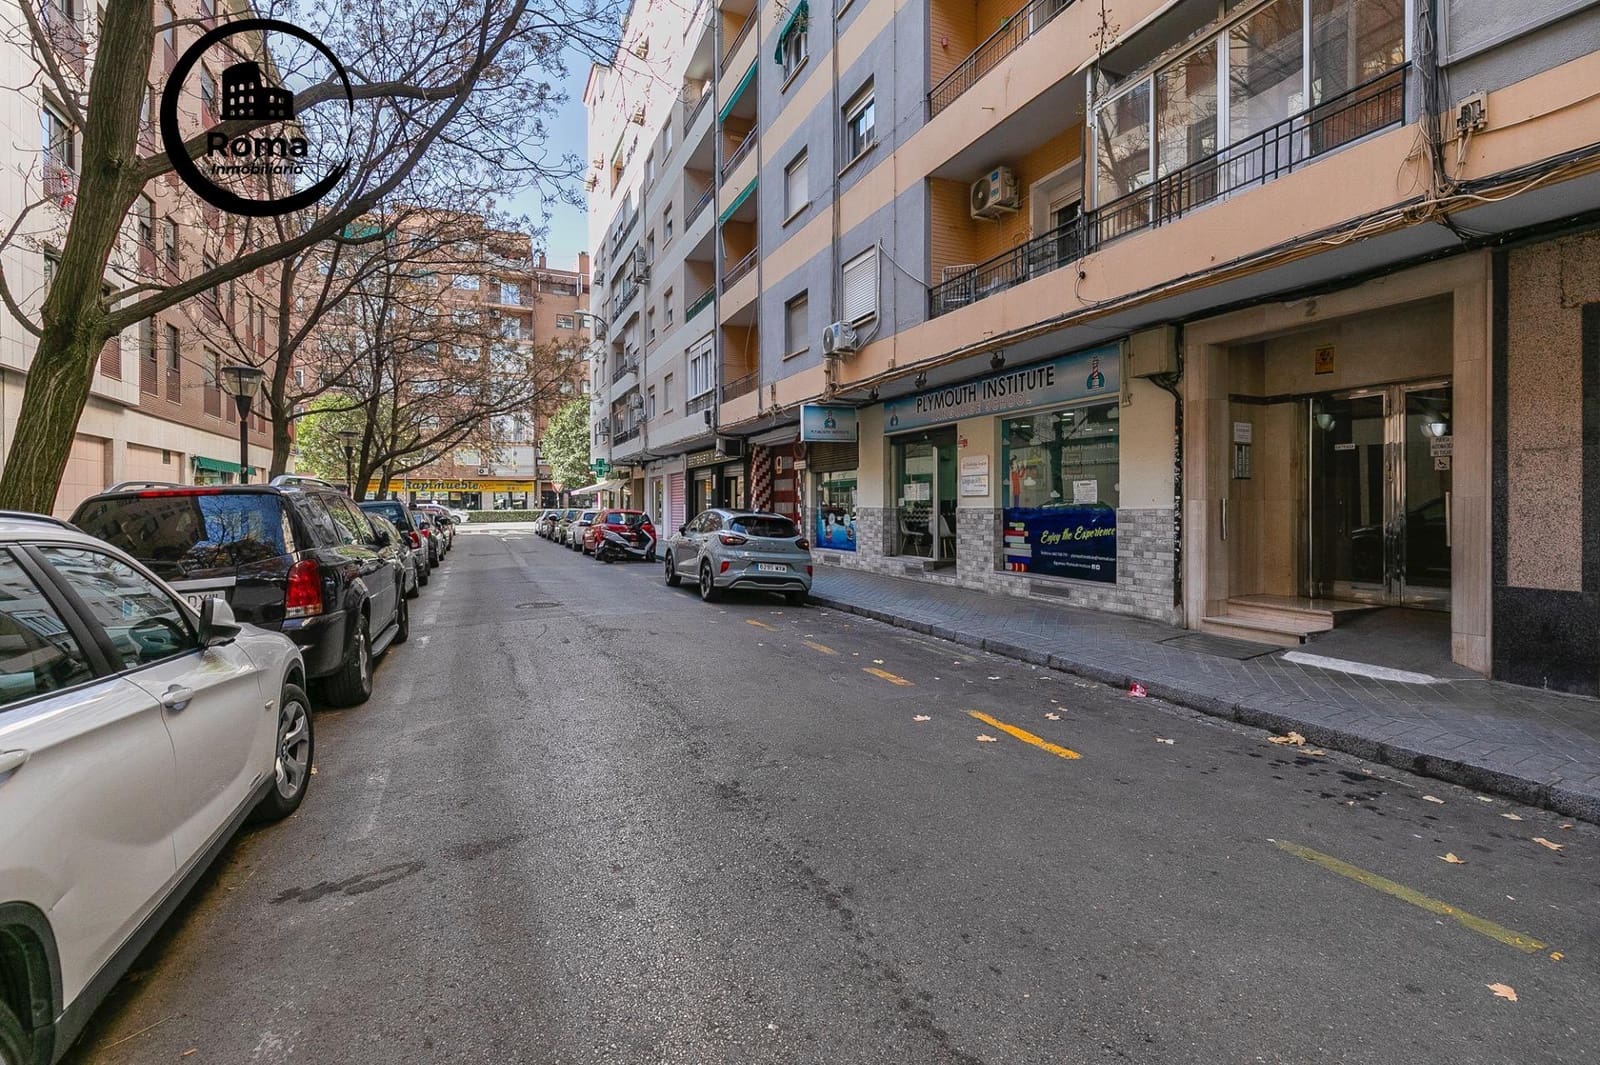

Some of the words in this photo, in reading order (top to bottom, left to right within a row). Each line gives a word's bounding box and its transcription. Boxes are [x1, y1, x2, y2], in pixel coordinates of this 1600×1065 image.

[916, 385, 977, 413] PLYMOUTH
[983, 365, 1055, 399] INSTITUTE
[404, 480, 478, 491] Rapimueble
[1040, 530, 1061, 545] Enjoy
[1074, 525, 1116, 541] Experience
